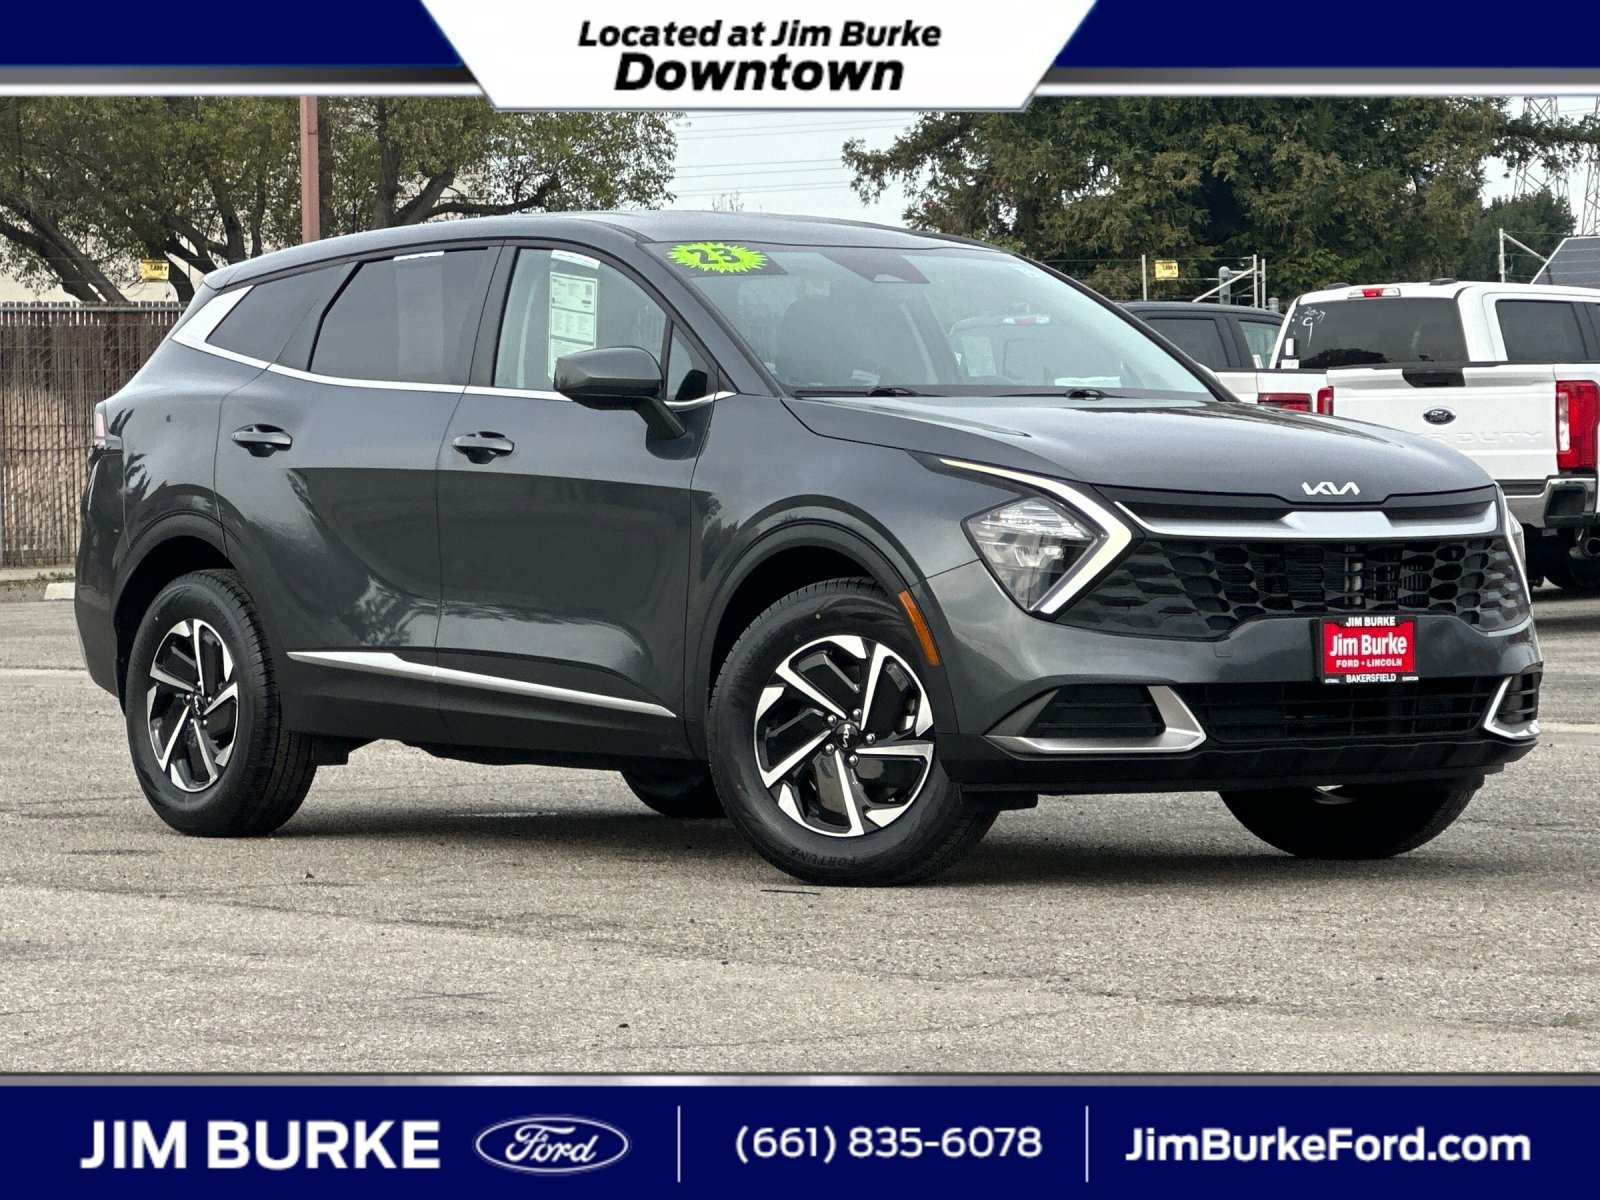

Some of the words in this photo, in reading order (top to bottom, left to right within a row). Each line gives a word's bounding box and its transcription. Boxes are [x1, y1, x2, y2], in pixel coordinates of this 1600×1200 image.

[687, 247, 741, 265] 23
[1302, 481, 1360, 495] KIA
[1345, 617, 1362, 627] JIM
[1364, 616, 1396, 627] BURKE
[1330, 633, 1358, 657] Jim
[1361, 632, 1407, 656] Burke
[1336, 659, 1359, 668] FORD
[1366, 658, 1402, 667] LINCOLN
[1346, 673, 1396, 683] BAKERSFIELD
